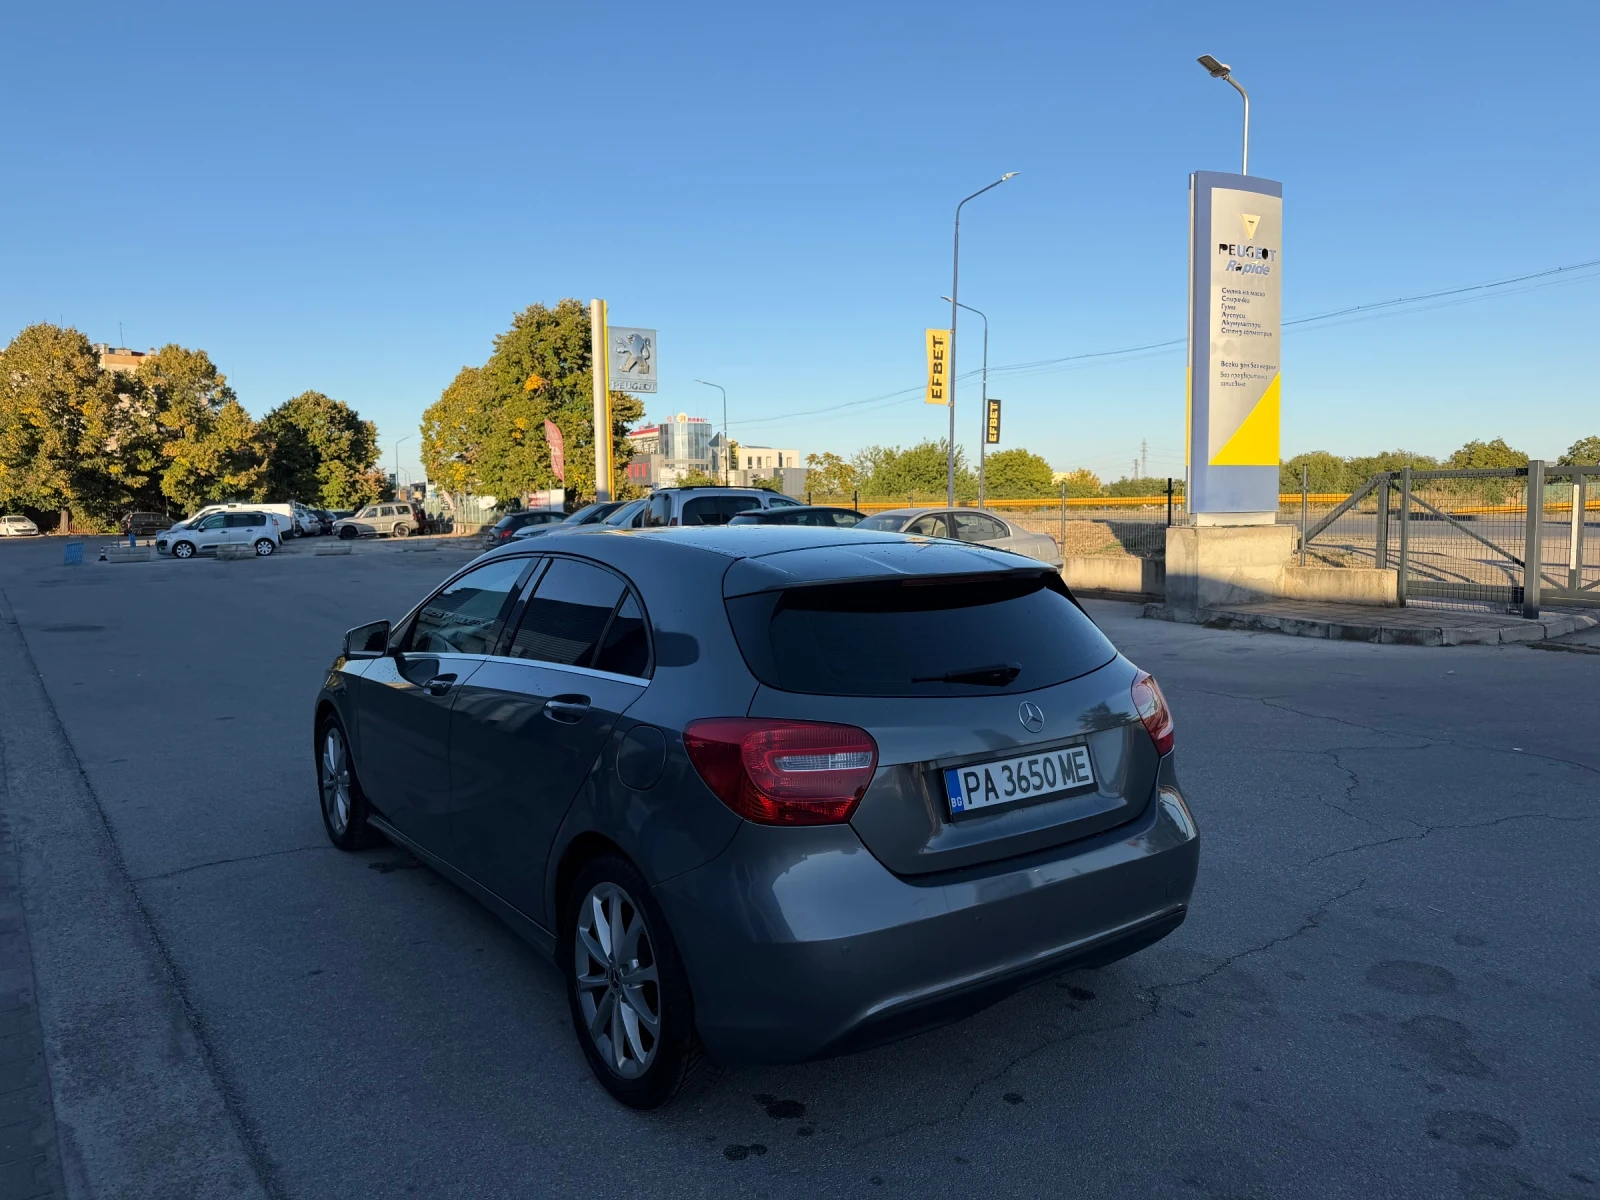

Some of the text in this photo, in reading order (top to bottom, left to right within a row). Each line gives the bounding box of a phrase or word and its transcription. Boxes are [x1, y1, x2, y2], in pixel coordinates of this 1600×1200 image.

[1218, 243, 1276, 261] PEUGEOT
[1225, 259, 1270, 275] Rapide
[931, 335, 944, 399] EFBET
[611, 380, 656, 391] PEUGEOT
[988, 402, 999, 442] EFBET
[963, 750, 1090, 805] PA 3650 ME
[951, 797, 963, 807] BG
